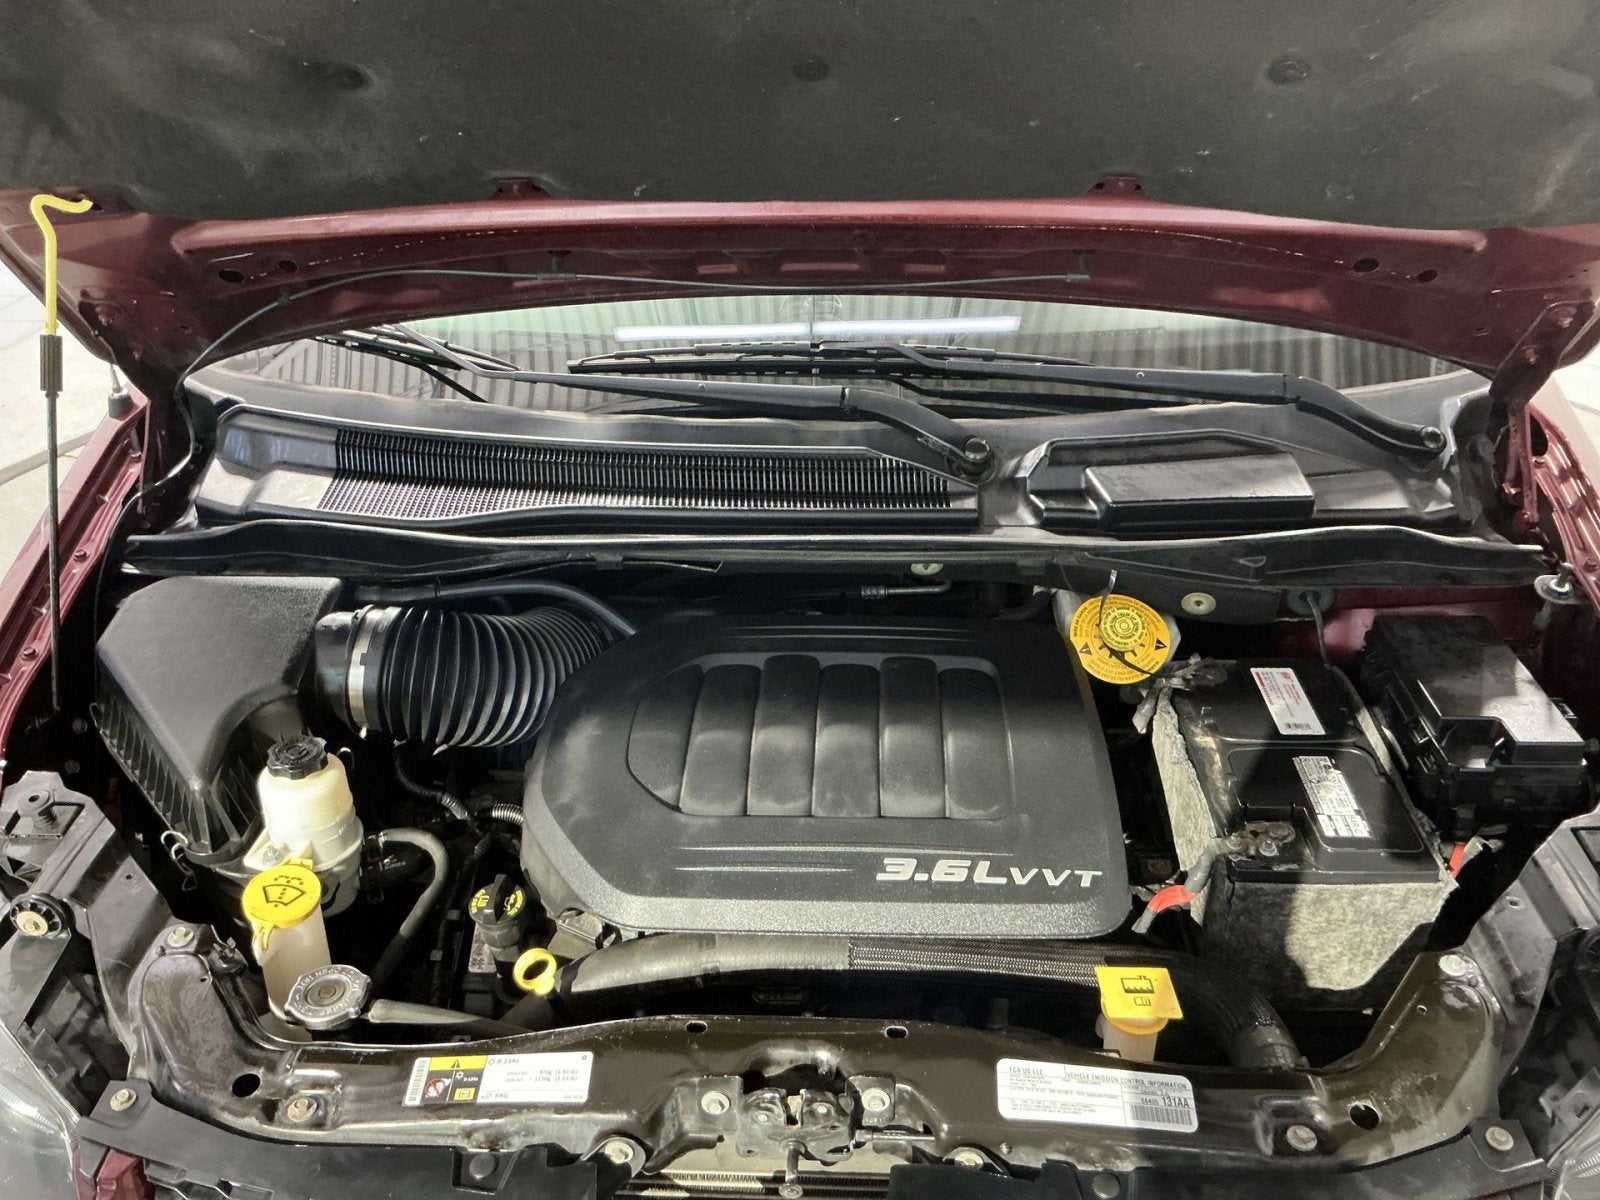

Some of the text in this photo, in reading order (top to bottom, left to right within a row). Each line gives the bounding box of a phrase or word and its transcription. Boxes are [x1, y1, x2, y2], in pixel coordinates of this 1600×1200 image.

[875, 857, 1103, 888] 3.6L VVT
[1067, 1071, 1090, 1080] VEHICLE
[1091, 1074, 1119, 1083] EMISSION
[1120, 1077, 1146, 1086] CONTROL
[1147, 1080, 1187, 1089] INFORMATION
[1162, 1096, 1189, 1108] 131AA
